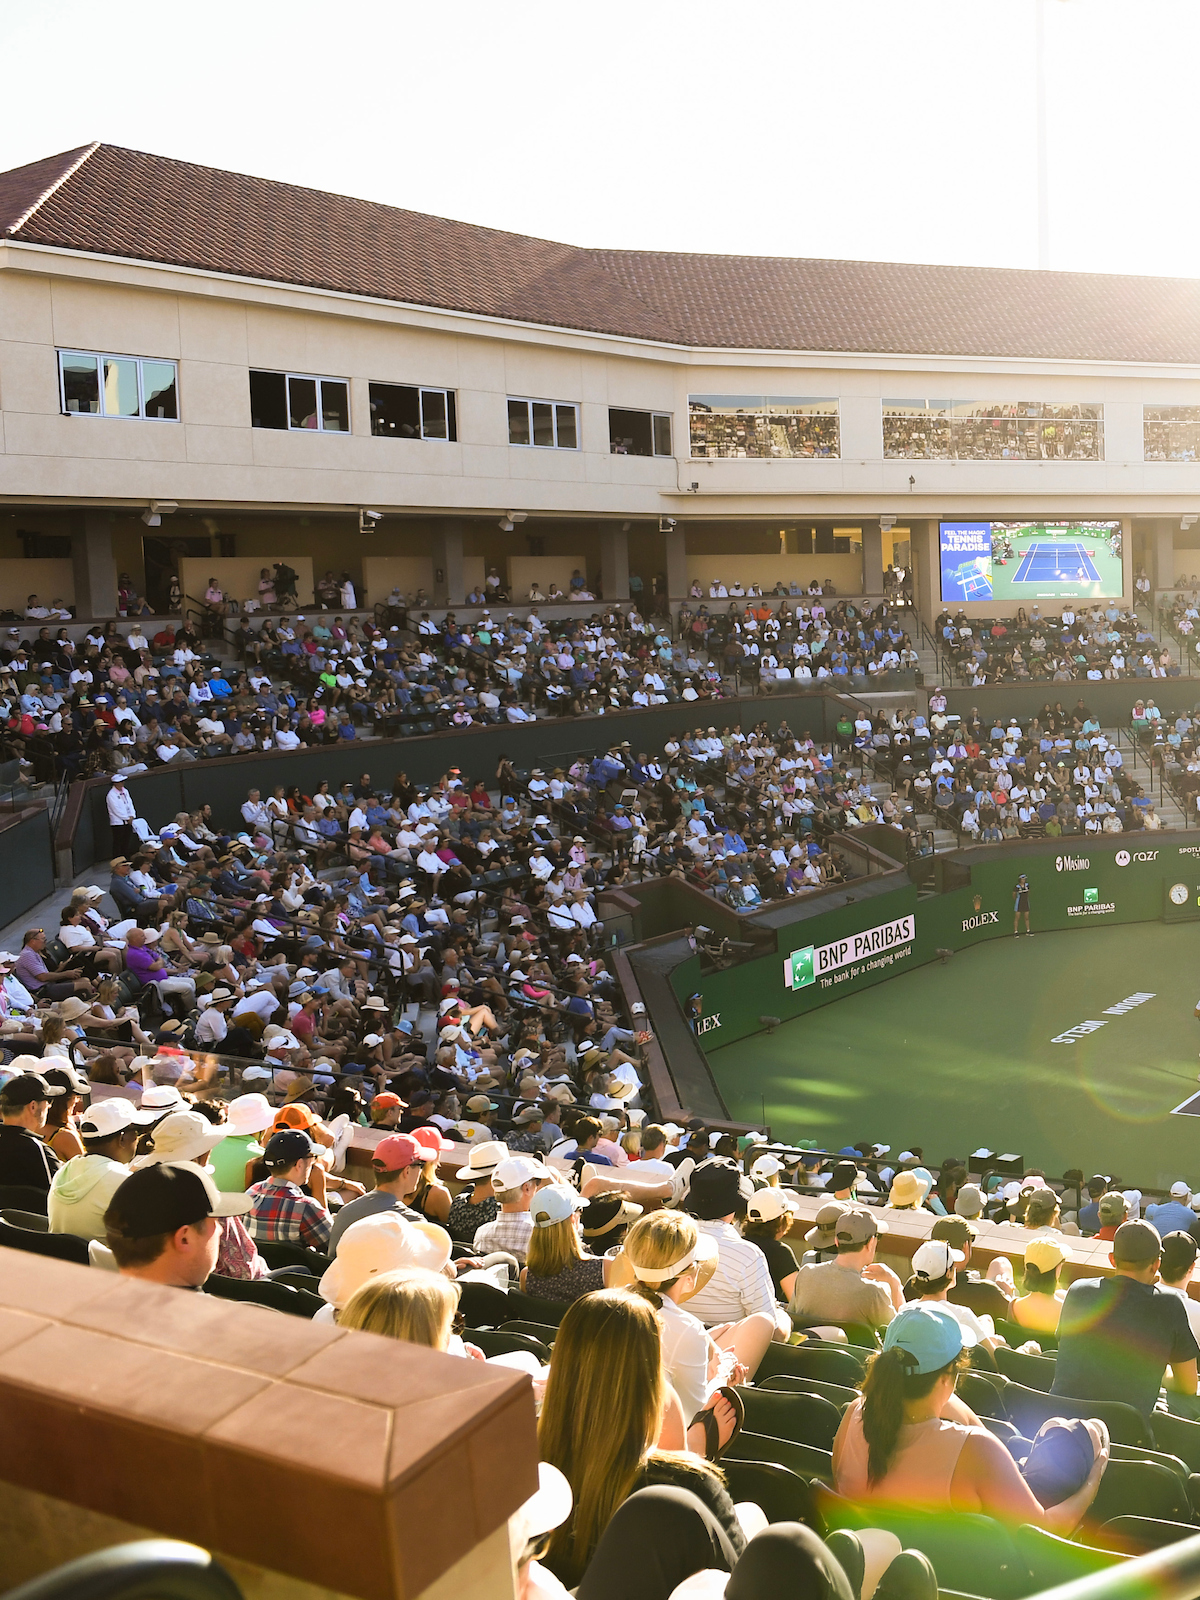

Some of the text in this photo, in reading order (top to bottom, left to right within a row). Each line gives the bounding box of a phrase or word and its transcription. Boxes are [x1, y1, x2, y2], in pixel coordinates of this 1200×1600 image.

[941, 543, 990, 551] PARADISE
[948, 535, 983, 543] TENNIS
[1132, 850, 1160, 862] razr
[1084, 903, 1115, 911] PARIBAS
[961, 911, 999, 932] ROLEX
[819, 919, 910, 970] BNP PARIBAS
[820, 945, 912, 989] The bank for a changing world
[1050, 1020, 1109, 1044] WELLS
